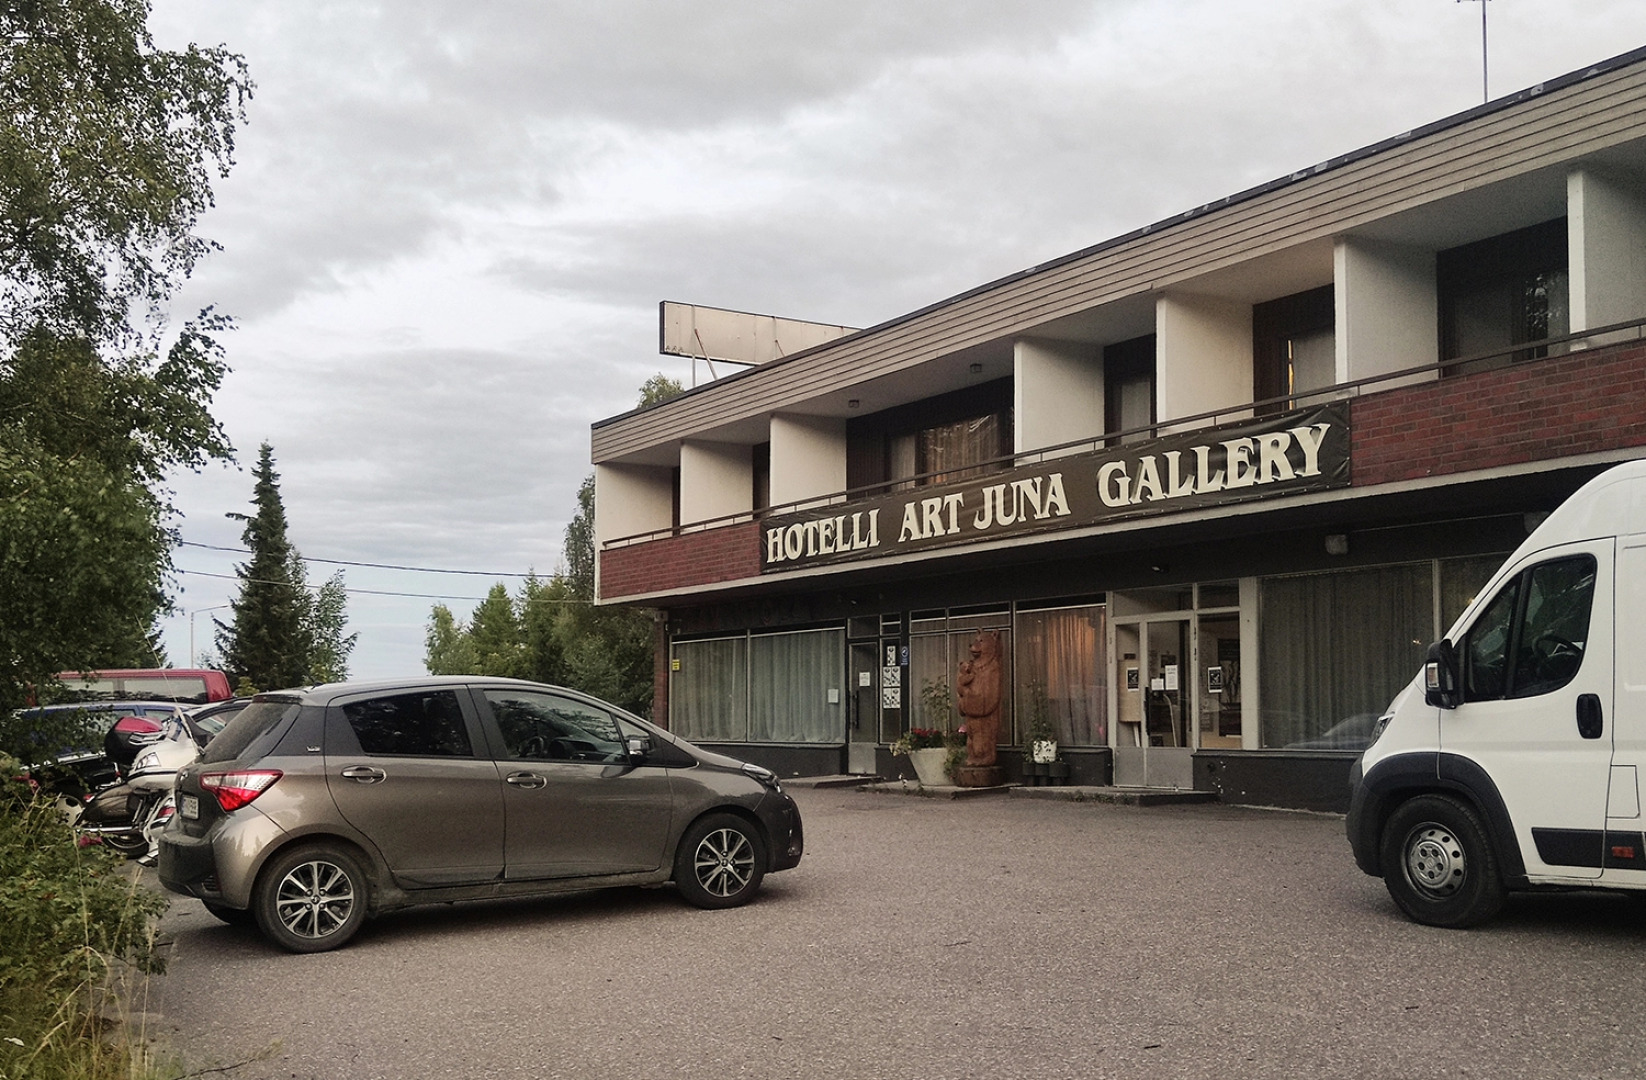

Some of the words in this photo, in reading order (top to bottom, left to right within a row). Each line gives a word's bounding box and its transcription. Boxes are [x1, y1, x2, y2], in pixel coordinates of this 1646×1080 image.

[766, 510, 880, 562] HOTELLI
[898, 493, 963, 543] ART
[973, 473, 1072, 530] JUNA
[1097, 423, 1331, 507] GALLERY
